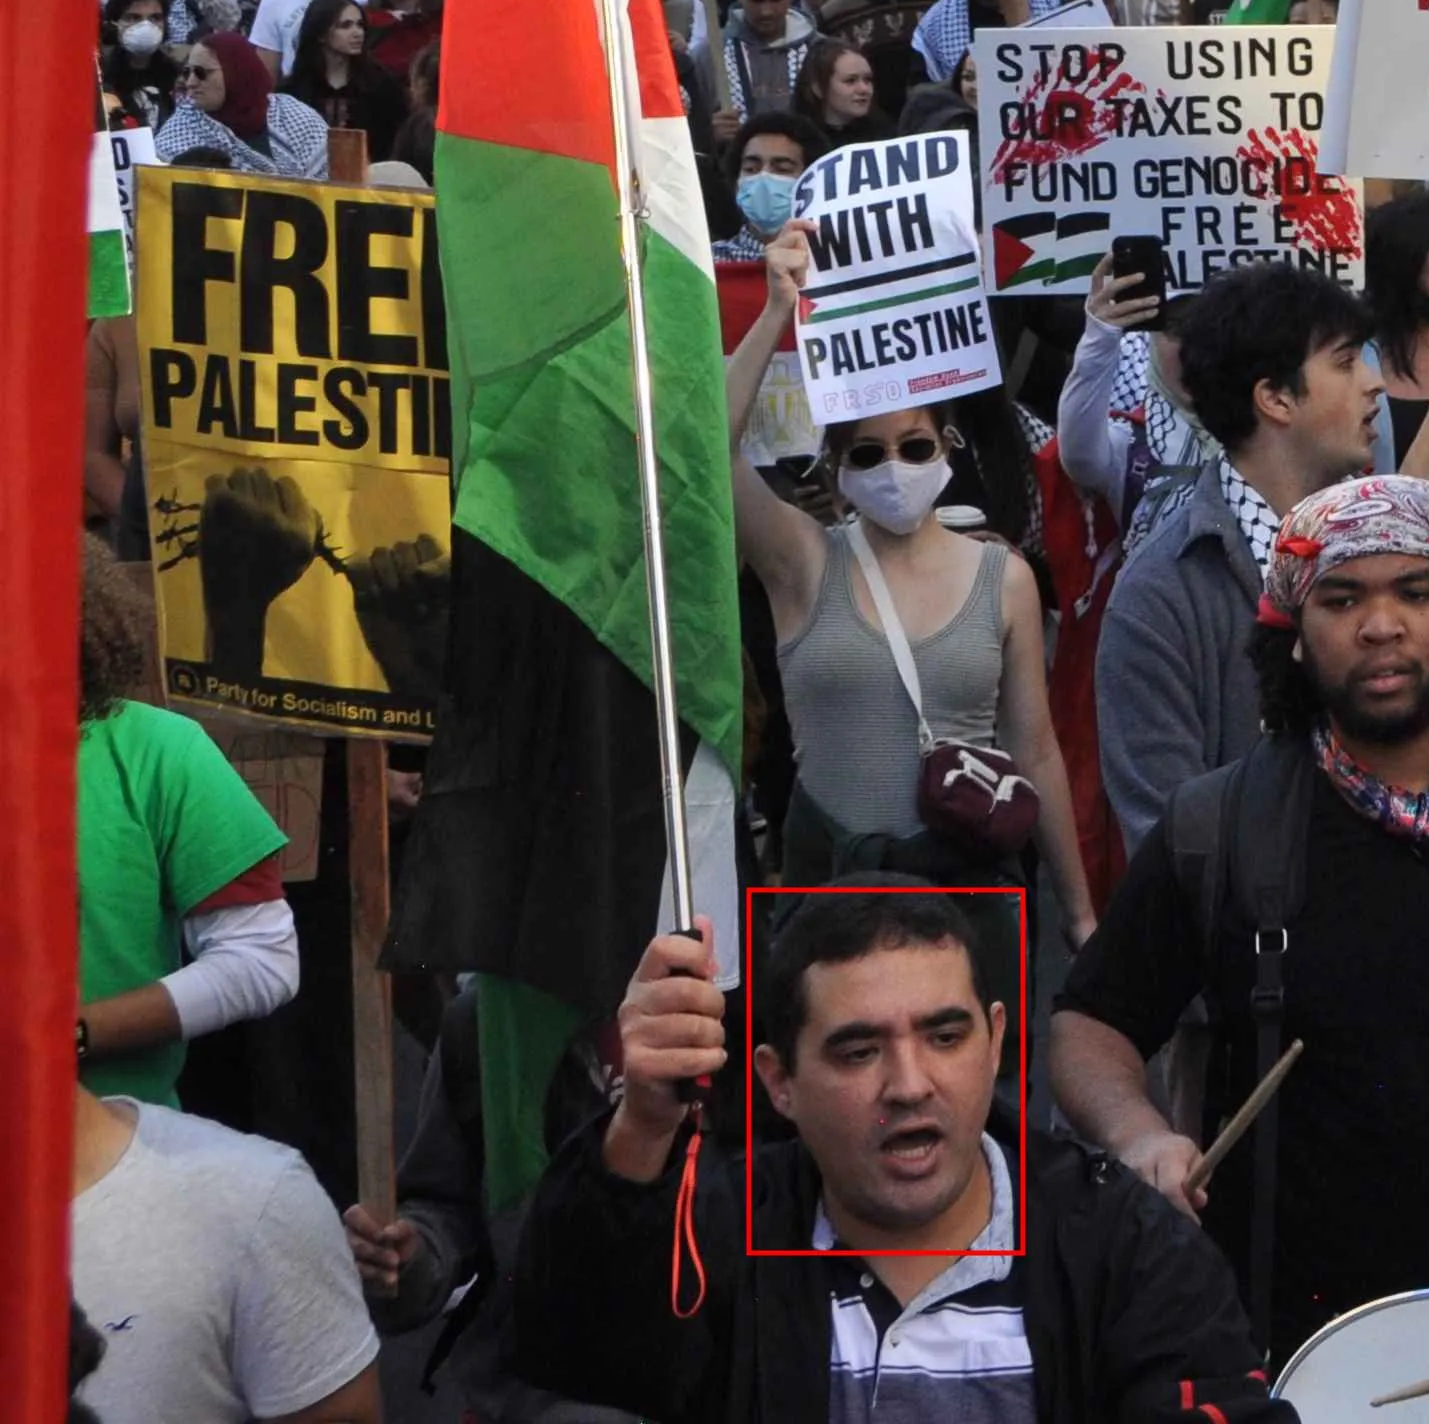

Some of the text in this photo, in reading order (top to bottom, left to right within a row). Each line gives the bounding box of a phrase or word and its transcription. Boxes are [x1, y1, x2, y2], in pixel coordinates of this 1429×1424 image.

[996, 36, 1314, 83] STOP USING
[1000, 91, 1324, 142] OUR TAXES TO
[795, 135, 960, 219] STAND
[1003, 159, 1117, 203] FUND
[804, 192, 936, 273] WITH
[1161, 204, 1296, 246] FREE
[804, 300, 988, 380] PALESTINE
[206, 677, 249, 705] Party
[250, 687, 277, 709] for
[282, 692, 377, 723] Socialism
[382, 708, 421, 726] and
